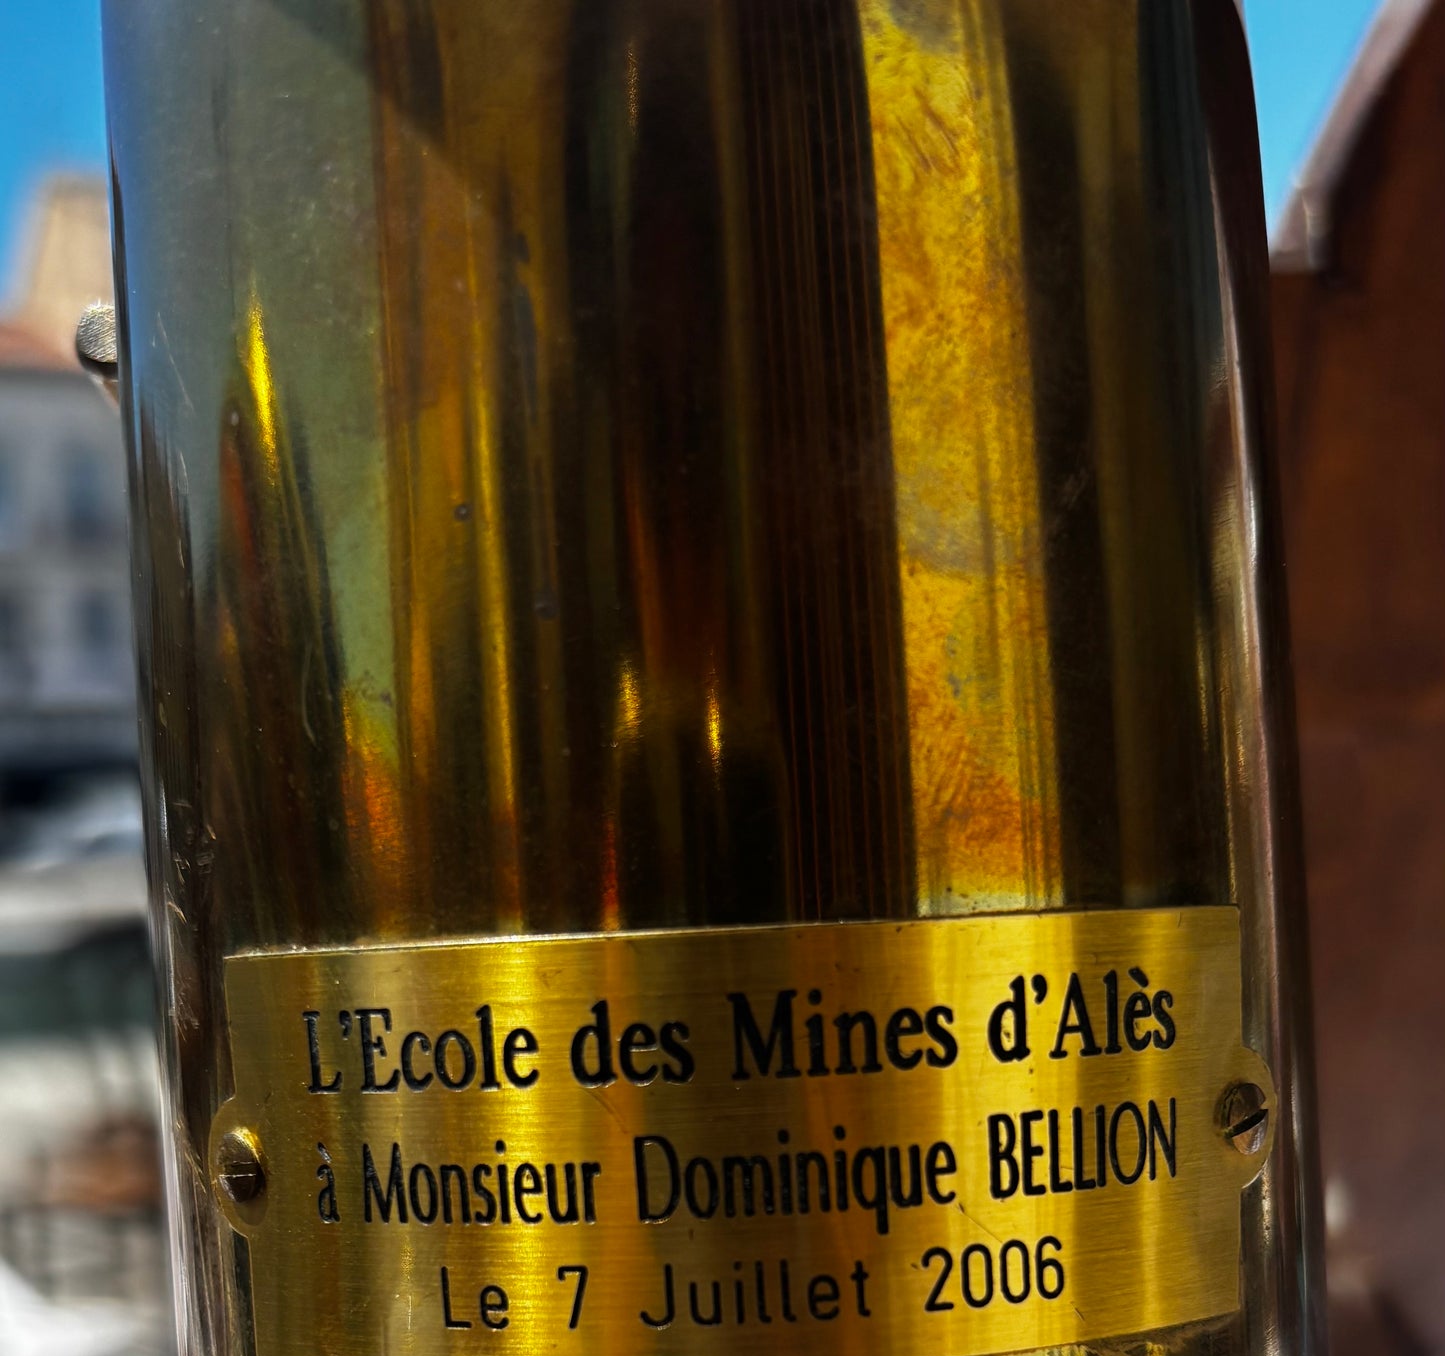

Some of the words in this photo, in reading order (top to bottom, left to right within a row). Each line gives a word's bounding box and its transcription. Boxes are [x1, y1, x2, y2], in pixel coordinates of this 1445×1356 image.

[303, 1003, 540, 1095] L'Ecole
[571, 1001, 696, 1088] des
[727, 989, 958, 1082] Mines
[988, 966, 1177, 1063] d'Alès
[316, 1142, 340, 1225] à
[362, 1140, 602, 1227] Monsieur
[634, 1125, 957, 1235] Dominique
[988, 1096, 1179, 1200] BELLION
[440, 1265, 510, 1331] Le
[556, 1265, 589, 1330] 7
[639, 1260, 871, 1328] Juillet
[921, 1236, 1065, 1313] 2006
